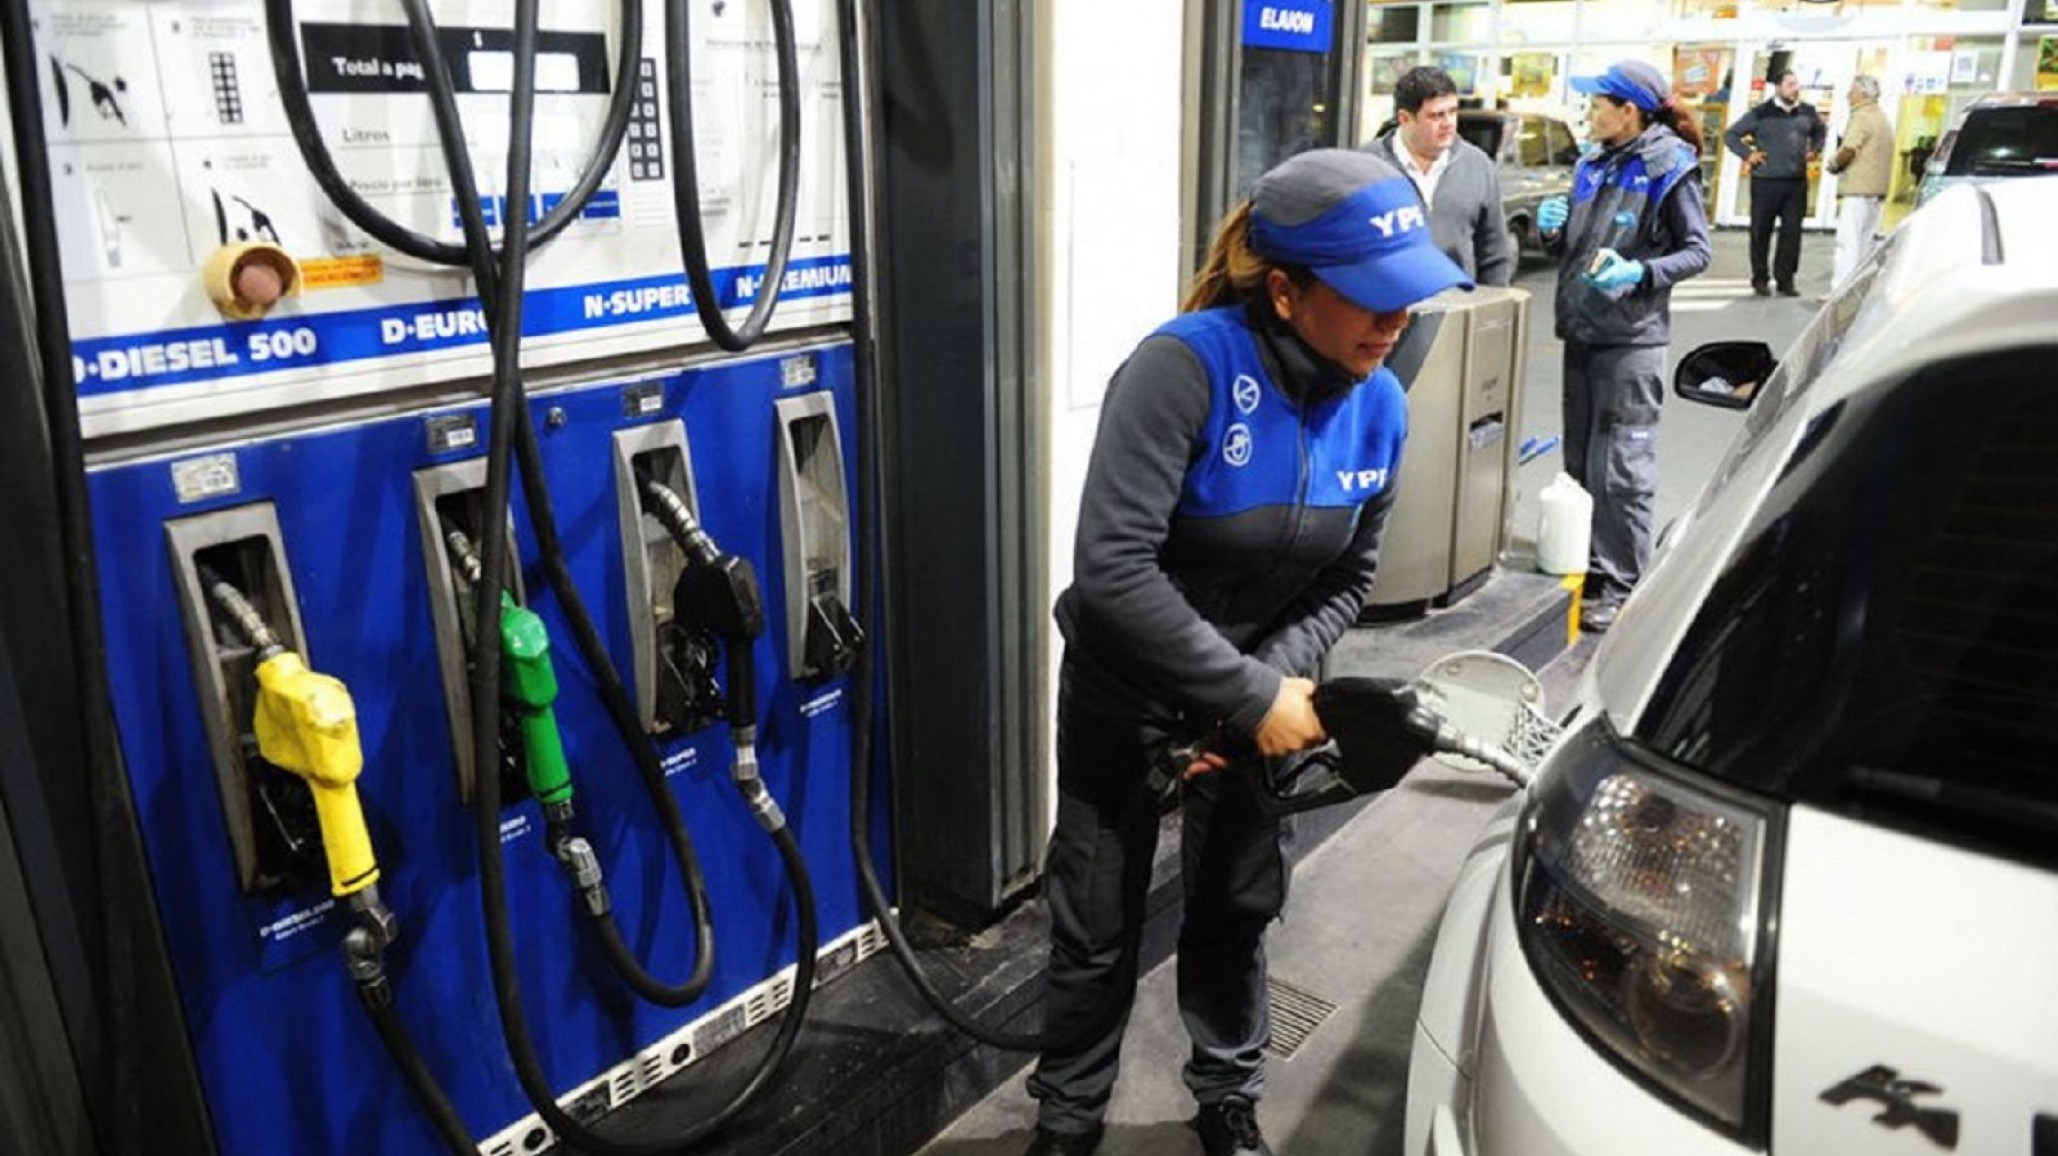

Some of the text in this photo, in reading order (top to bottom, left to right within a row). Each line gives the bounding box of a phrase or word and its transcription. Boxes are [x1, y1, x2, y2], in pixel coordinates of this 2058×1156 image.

[331, 56, 426, 81] Total a pag
[342, 129, 390, 142] Litros
[248, 327, 316, 361] 500
